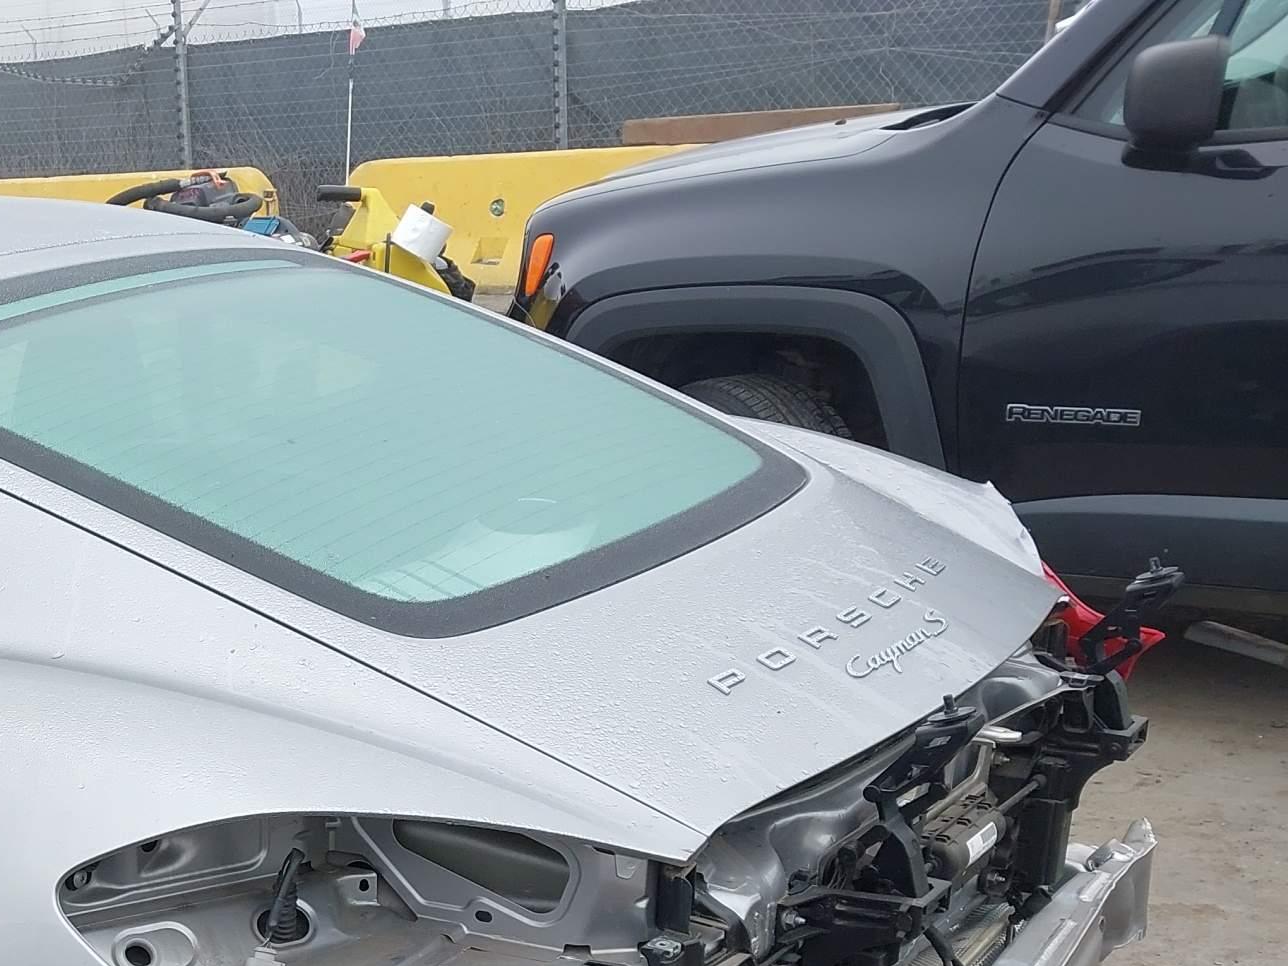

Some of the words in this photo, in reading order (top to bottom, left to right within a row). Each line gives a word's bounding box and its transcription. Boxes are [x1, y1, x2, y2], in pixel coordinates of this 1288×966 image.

[1006, 403, 1142, 426] RENEGADE
[706, 556, 947, 696] PORSCHE
[845, 628, 932, 678] Cayman
[922, 607, 950, 638] S
